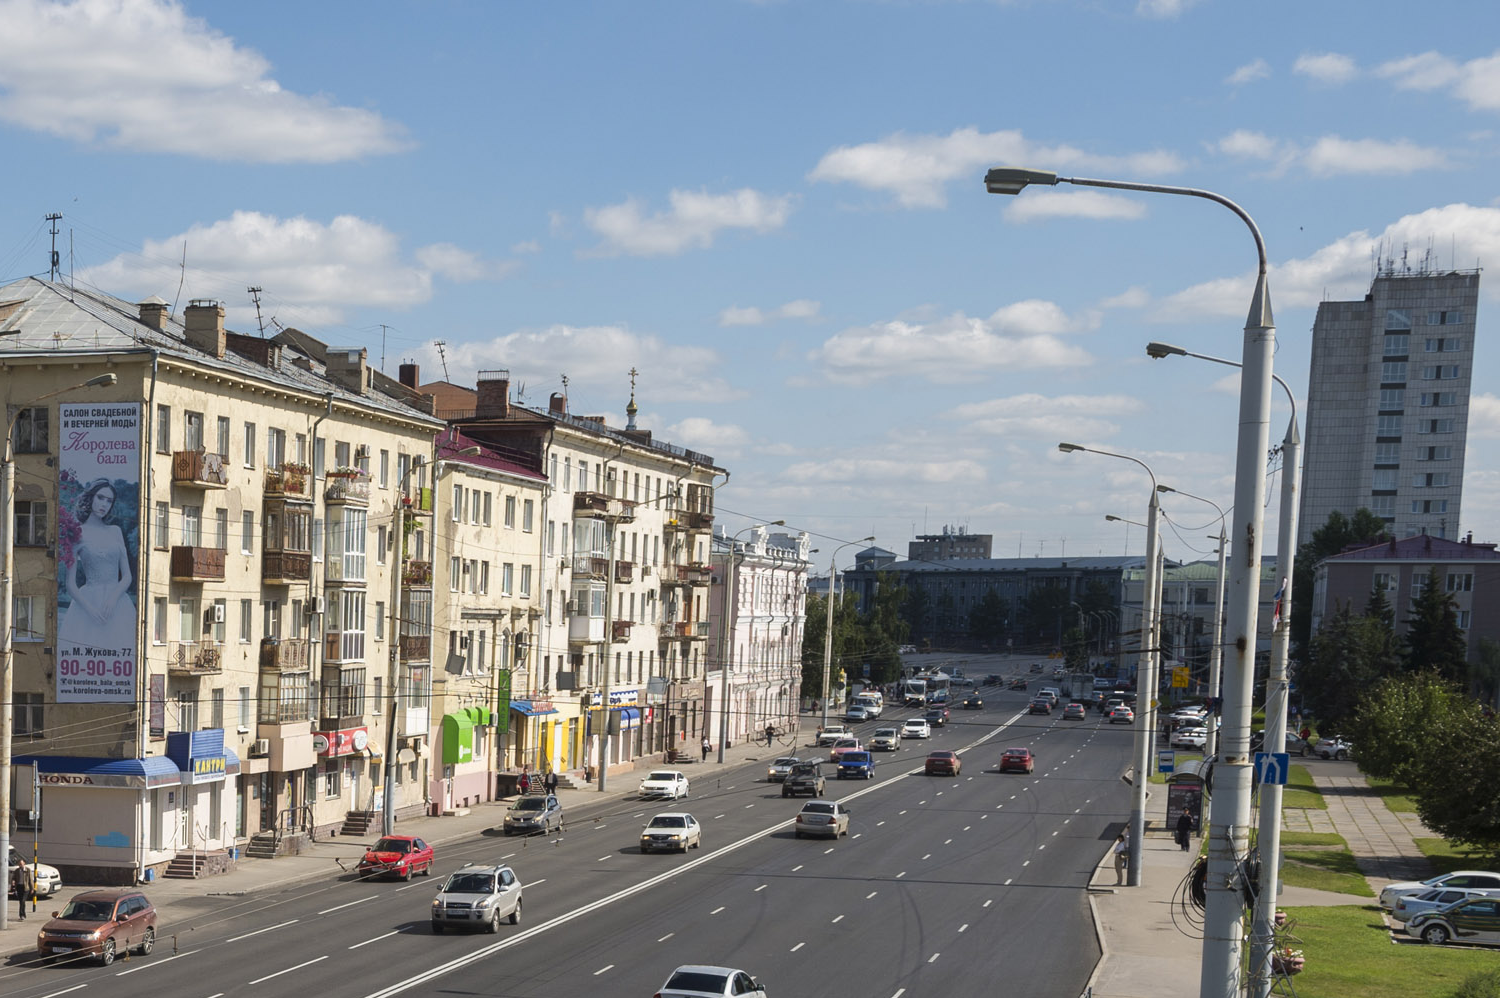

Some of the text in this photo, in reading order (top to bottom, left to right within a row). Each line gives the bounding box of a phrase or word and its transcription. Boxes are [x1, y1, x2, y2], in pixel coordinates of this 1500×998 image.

[63, 407, 137, 418] САЛОН СВАДЕБНОЙ
[63, 418, 137, 429] И ВЕЧЕРНЕЙ МОДЫ
[62, 431, 136, 454] Королева
[96, 450, 128, 465] бала
[121, 648, 132, 657] 77
[60, 659, 133, 677] 90-90-60
[195, 757, 226, 774] КАНТРИ
[38, 775, 94, 785] HONDA
